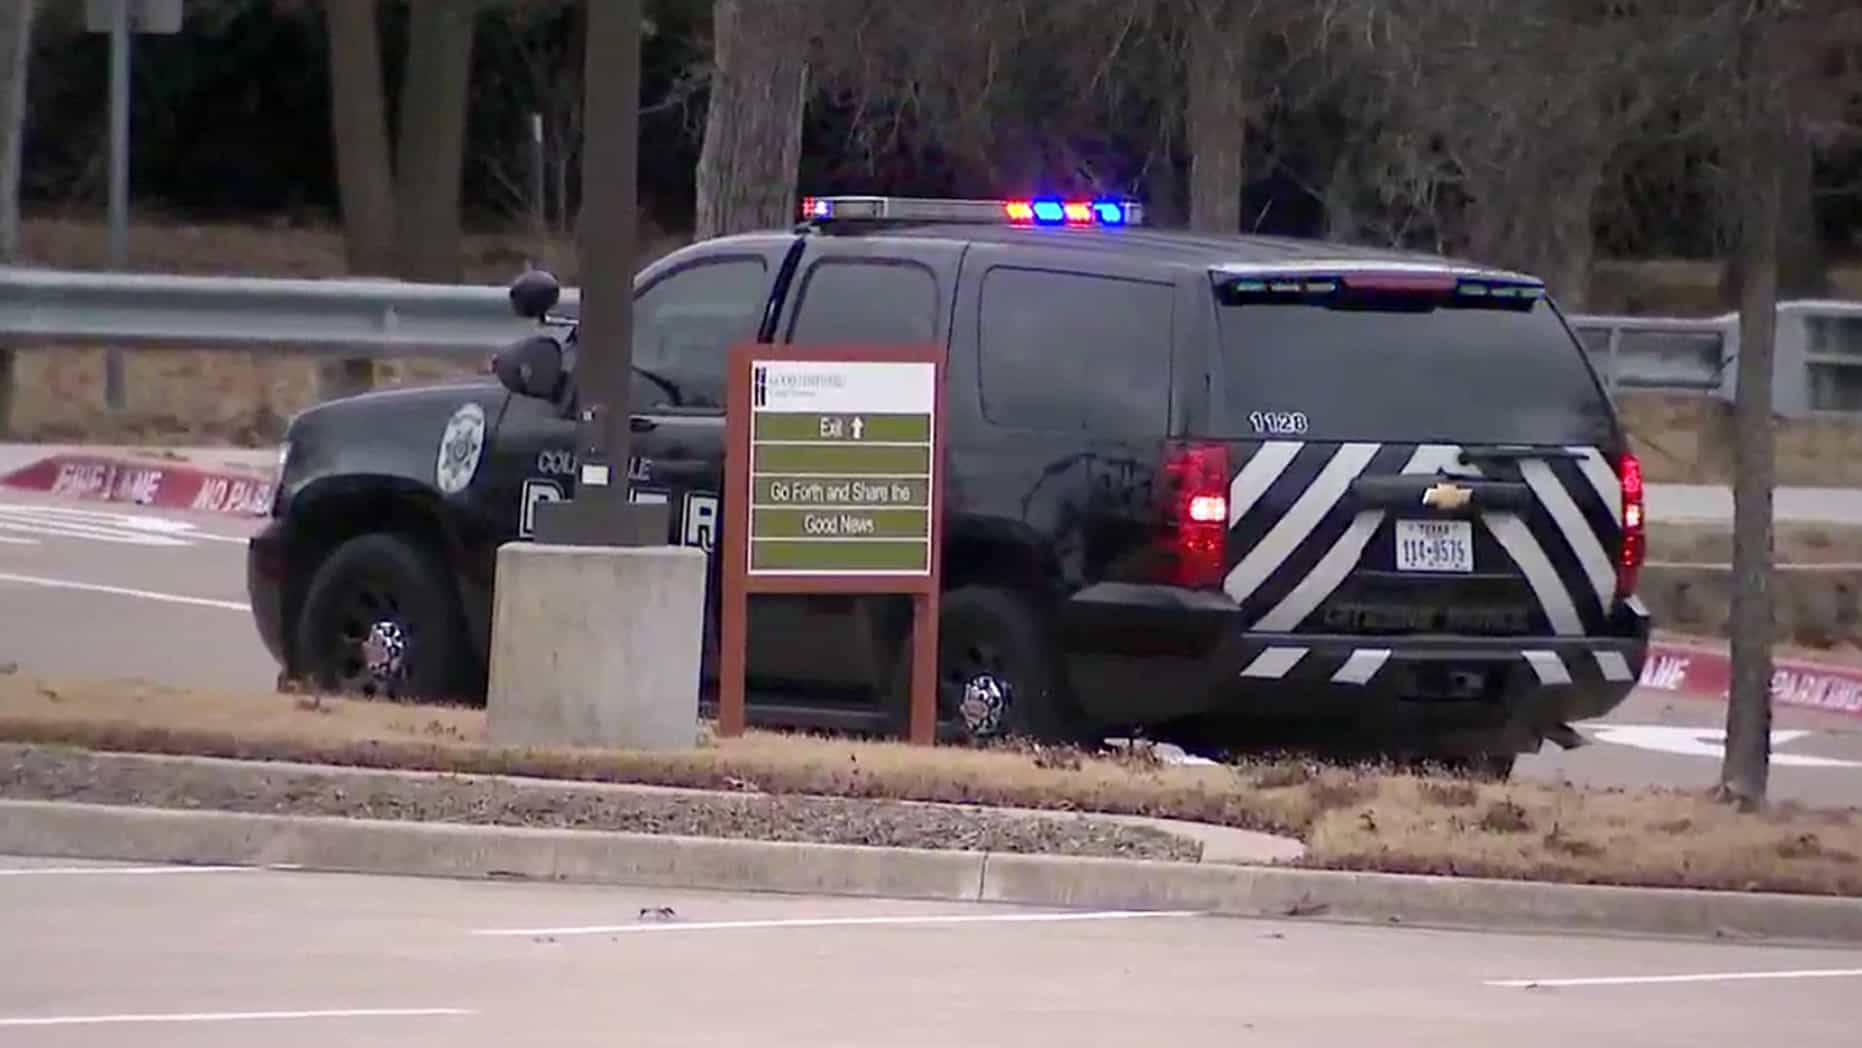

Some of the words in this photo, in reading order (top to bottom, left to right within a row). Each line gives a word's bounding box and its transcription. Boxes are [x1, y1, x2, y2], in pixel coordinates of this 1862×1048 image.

[820, 417, 843, 437] Exit
[1249, 411, 1308, 433] 1128
[192, 478, 229, 510] NO
[770, 481, 788, 501] Go
[792, 481, 825, 502] Forth
[827, 481, 850, 501] and
[852, 481, 889, 502] Share
[891, 482, 910, 501] the
[804, 514, 837, 534] Good
[839, 514, 874, 534] News
[1638, 655, 1691, 690] ANE
